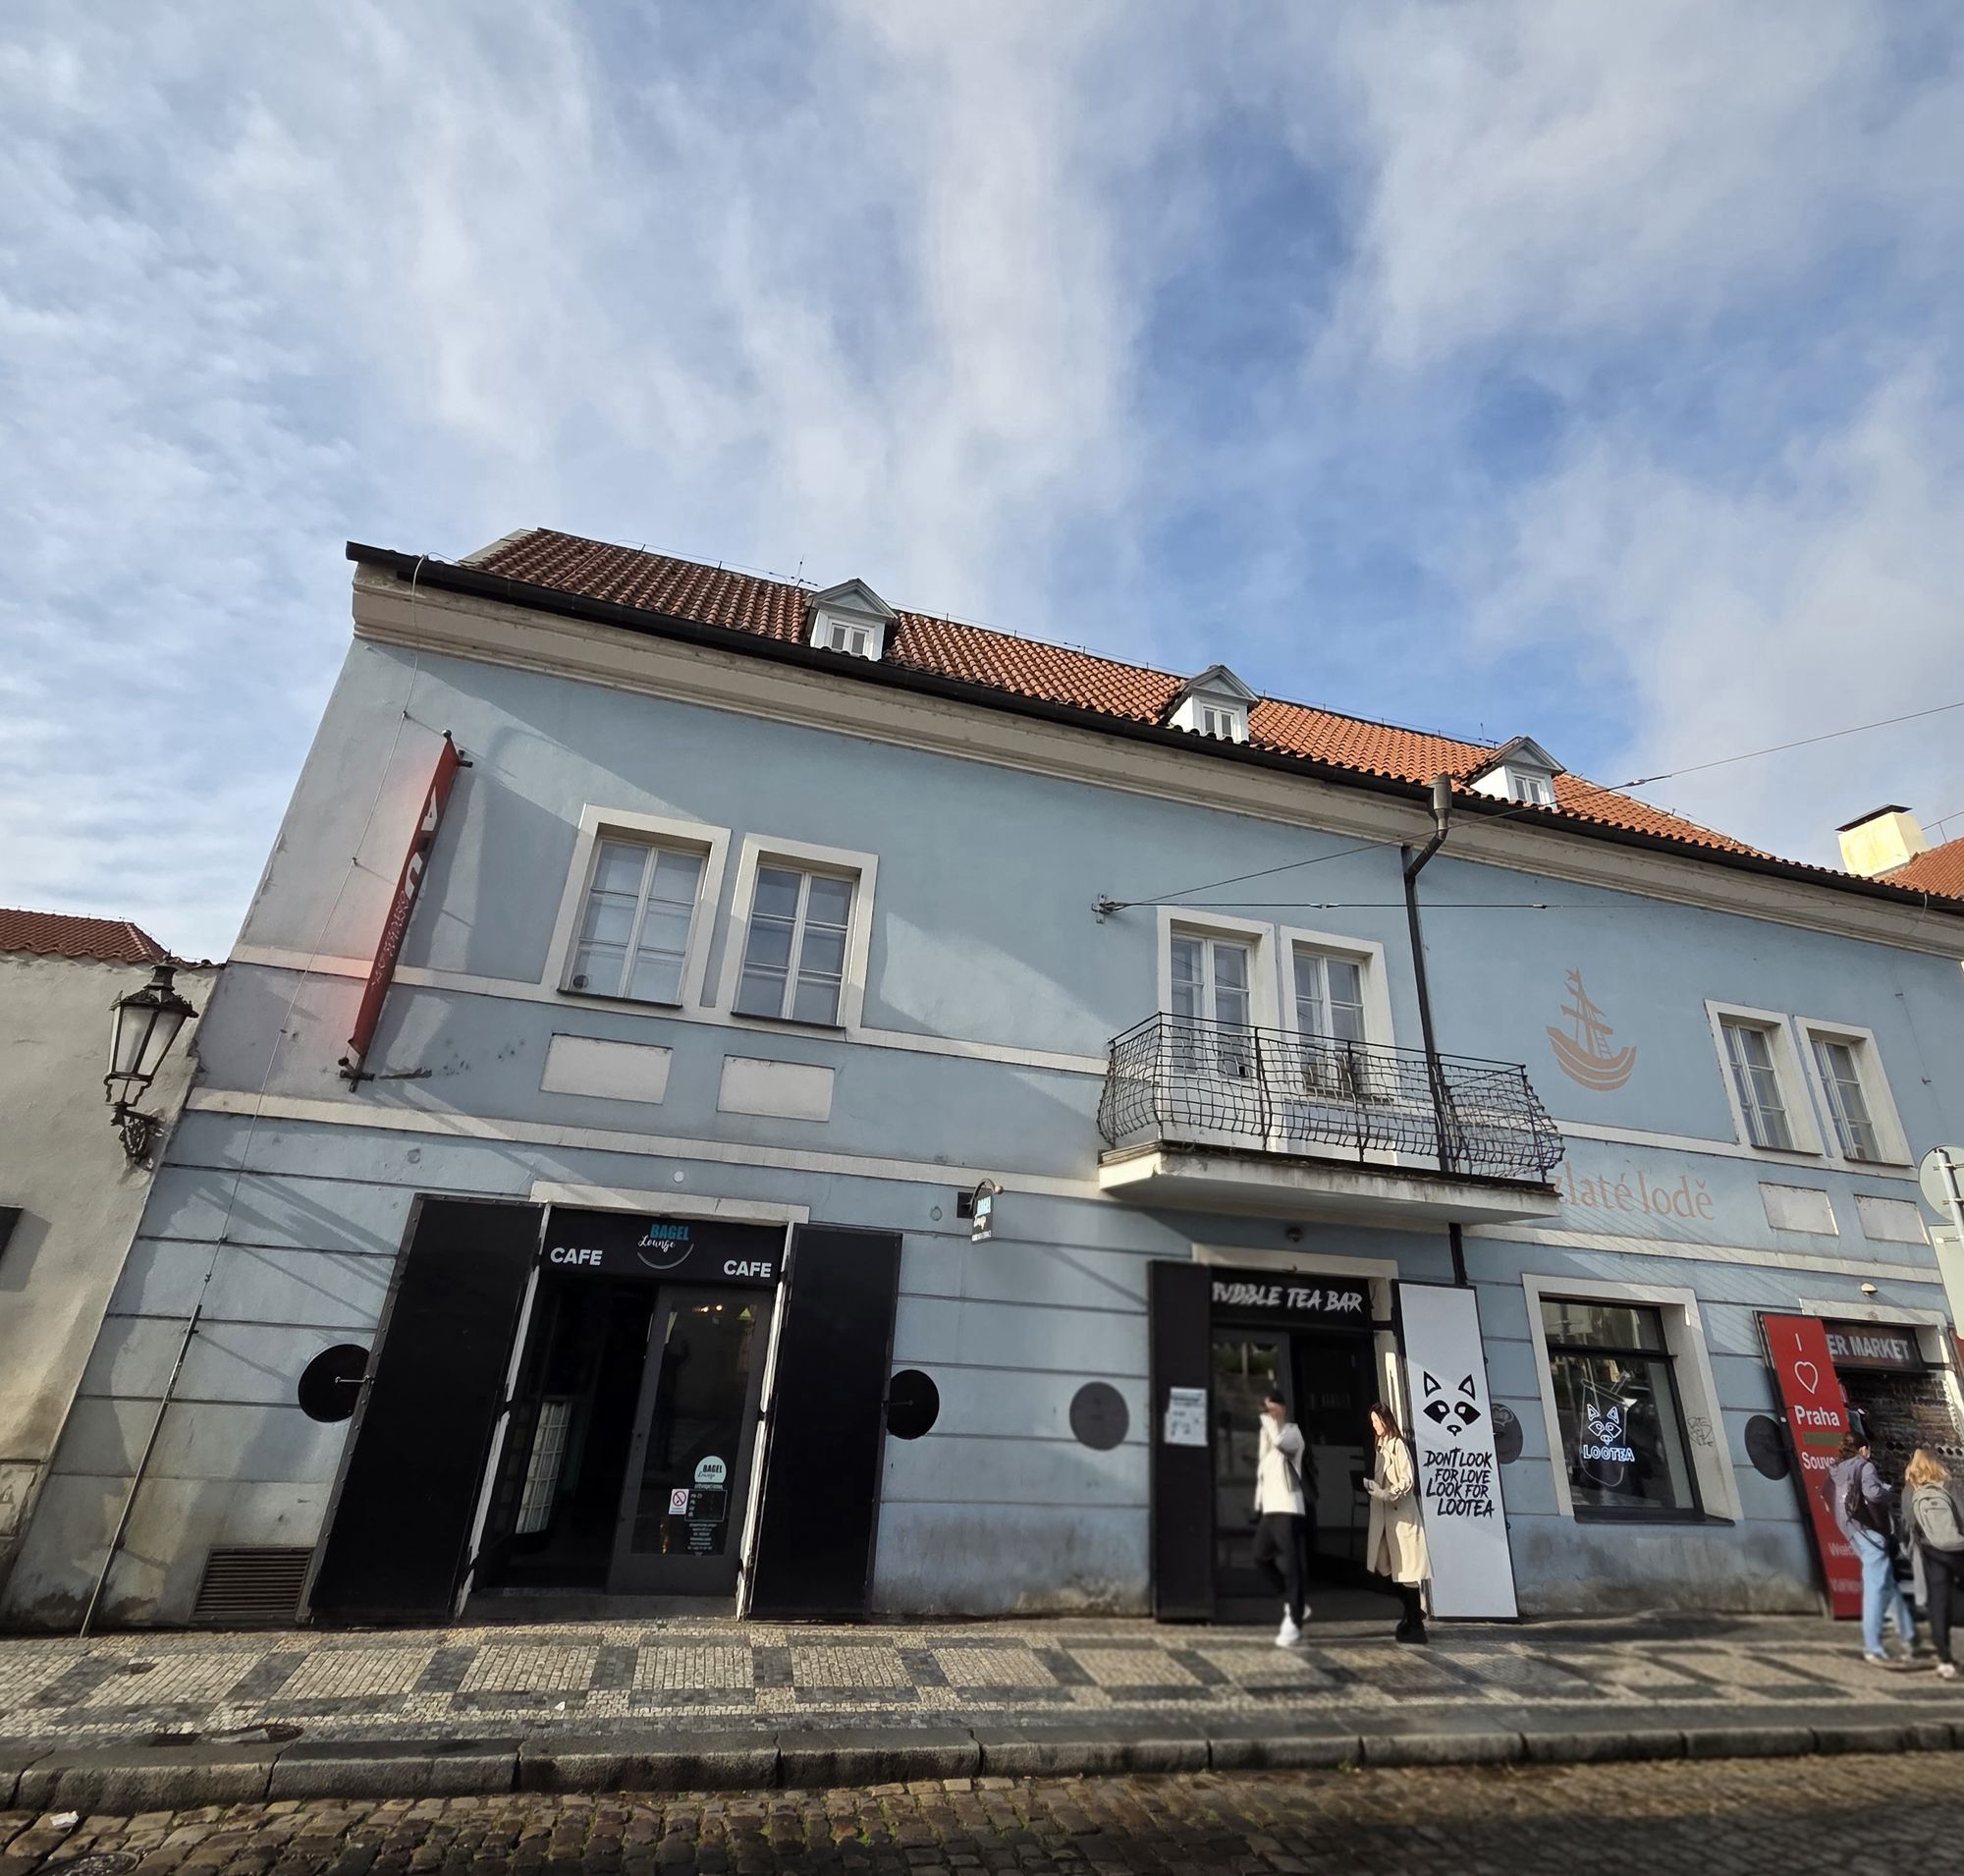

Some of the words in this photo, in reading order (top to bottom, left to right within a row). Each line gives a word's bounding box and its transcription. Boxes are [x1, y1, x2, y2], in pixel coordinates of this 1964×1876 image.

[1637, 1170, 1716, 1221] lodě
[650, 1224, 689, 1241] BAGEL
[638, 1235, 676, 1252] Lounge
[550, 1246, 603, 1266] CAFE
[723, 1259, 772, 1278] CAFE
[1286, 1287, 1323, 1311] TEA
[1323, 1290, 1363, 1314] BAR
[1794, 1332, 1803, 1352] I
[1849, 1335, 1910, 1361] MARKET
[1793, 1405, 1841, 1427] Praha
[1423, 1447, 1461, 1468] DONT
[1459, 1452, 1493, 1470] LOOK
[1582, 1444, 1636, 1462] LOOTEA
[702, 1464, 723, 1473] BAGEL
[1435, 1468, 1458, 1483] FOR
[1460, 1468, 1492, 1484] LOVE
[1426, 1477, 1462, 1500] LOOK
[1465, 1484, 1489, 1499] FOR
[1438, 1498, 1495, 1519] LOOTEA
